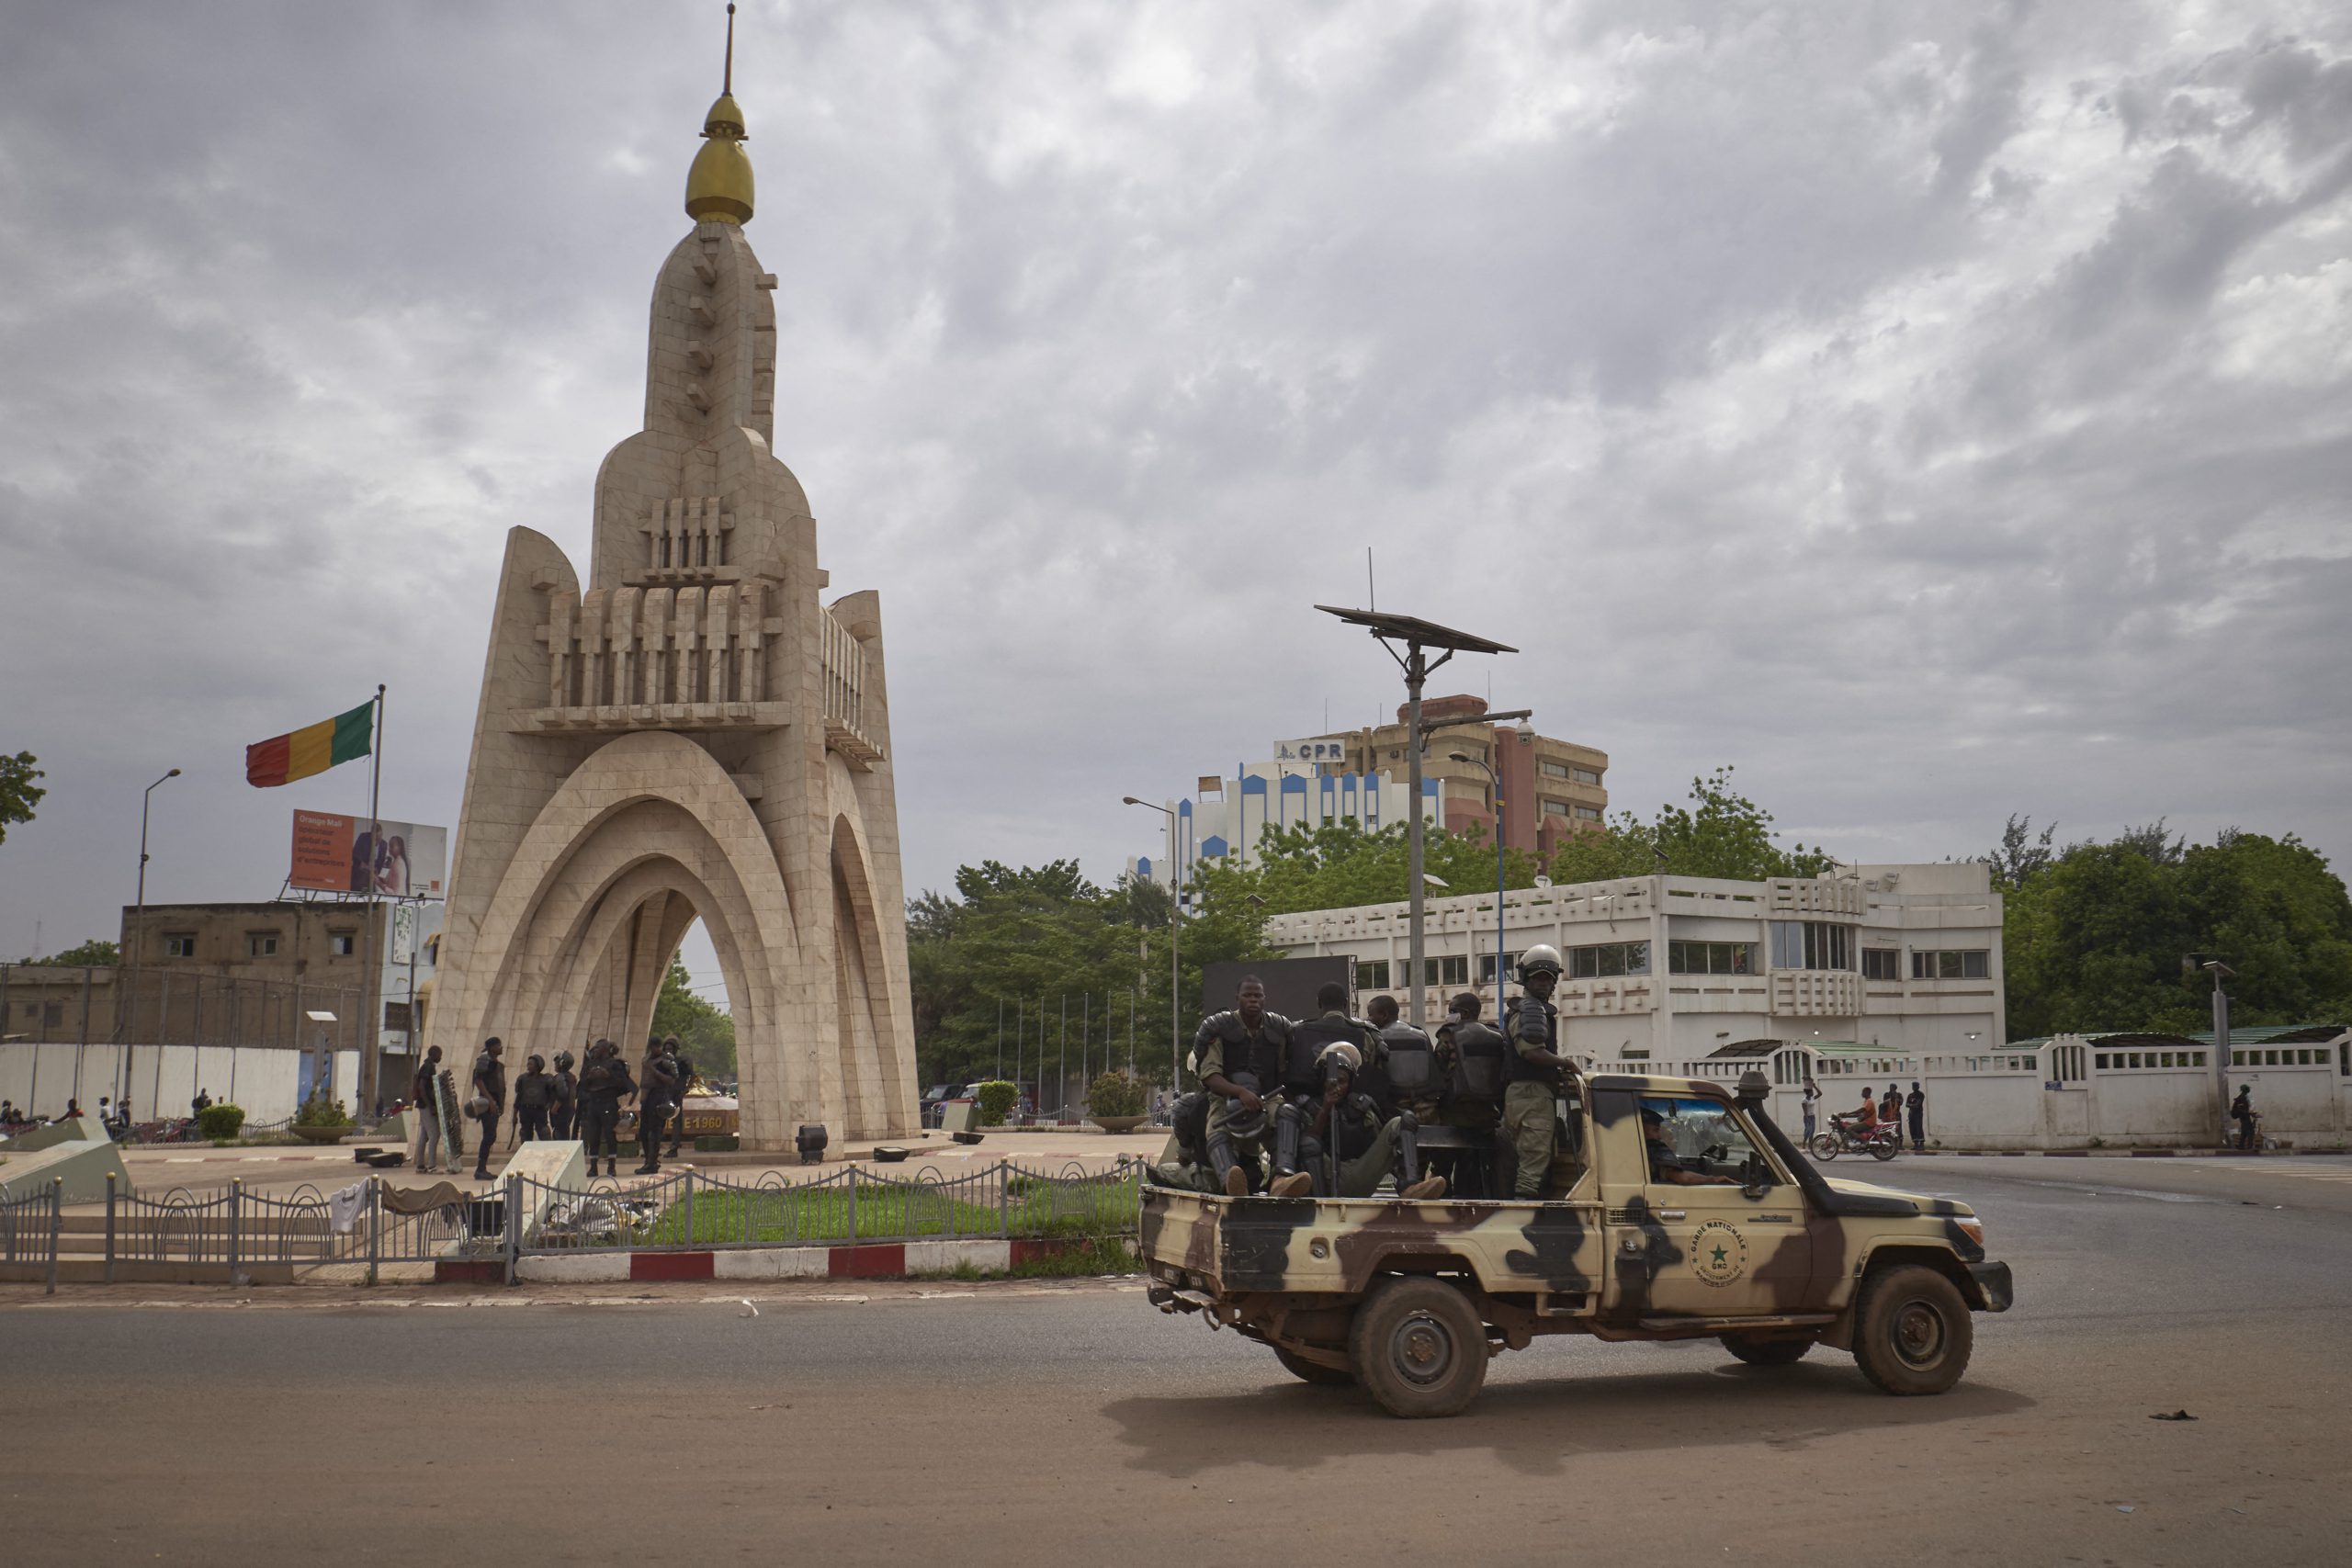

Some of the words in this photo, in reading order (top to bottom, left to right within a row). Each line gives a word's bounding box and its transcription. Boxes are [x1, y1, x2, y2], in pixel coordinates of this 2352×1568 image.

[1300, 744, 1341, 759] CPR
[300, 815, 325, 826] Orange
[693, 1116, 722, 1129] 1960
[1690, 1225, 1707, 1252] GARDE
[1706, 1221, 1747, 1250] NATIONALE
